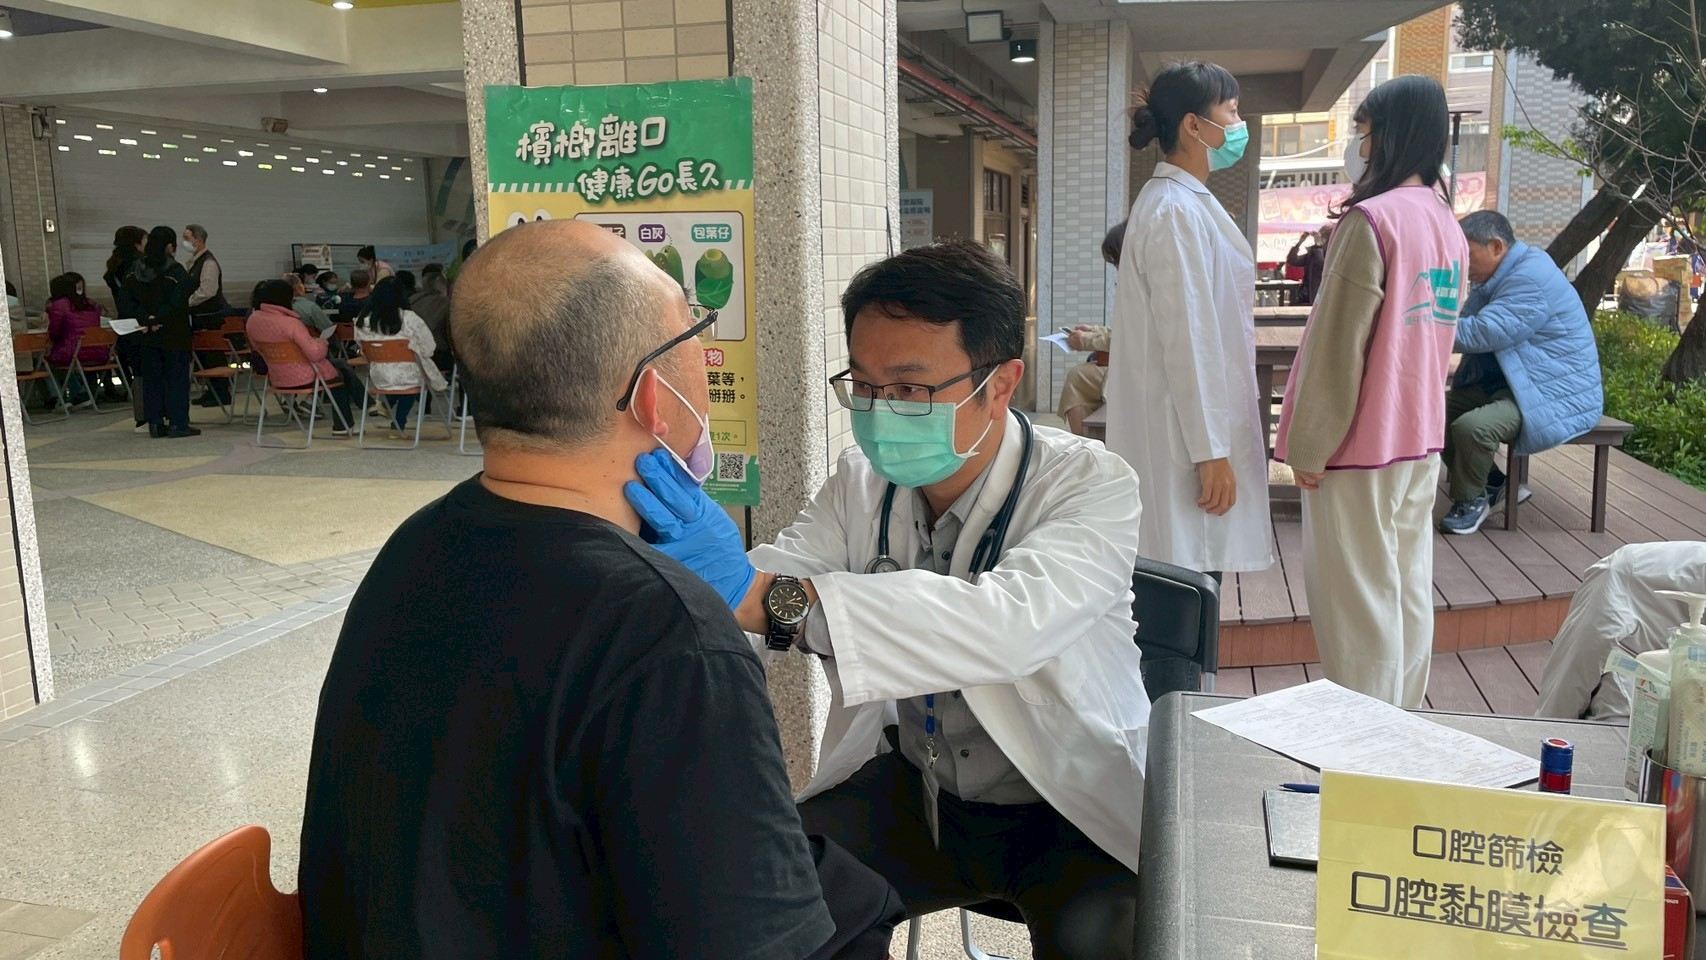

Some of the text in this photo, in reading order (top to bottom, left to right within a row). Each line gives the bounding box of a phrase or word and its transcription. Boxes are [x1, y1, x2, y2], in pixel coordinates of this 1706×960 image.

[515, 113, 667, 166] 檳榔離口
[577, 160, 720, 201] 健康Go長久
[640, 227, 664, 240] 白灰
[1413, 824, 1565, 876] 口腔篩檢
[1351, 870, 1628, 947] 口腔黏膜檢查
